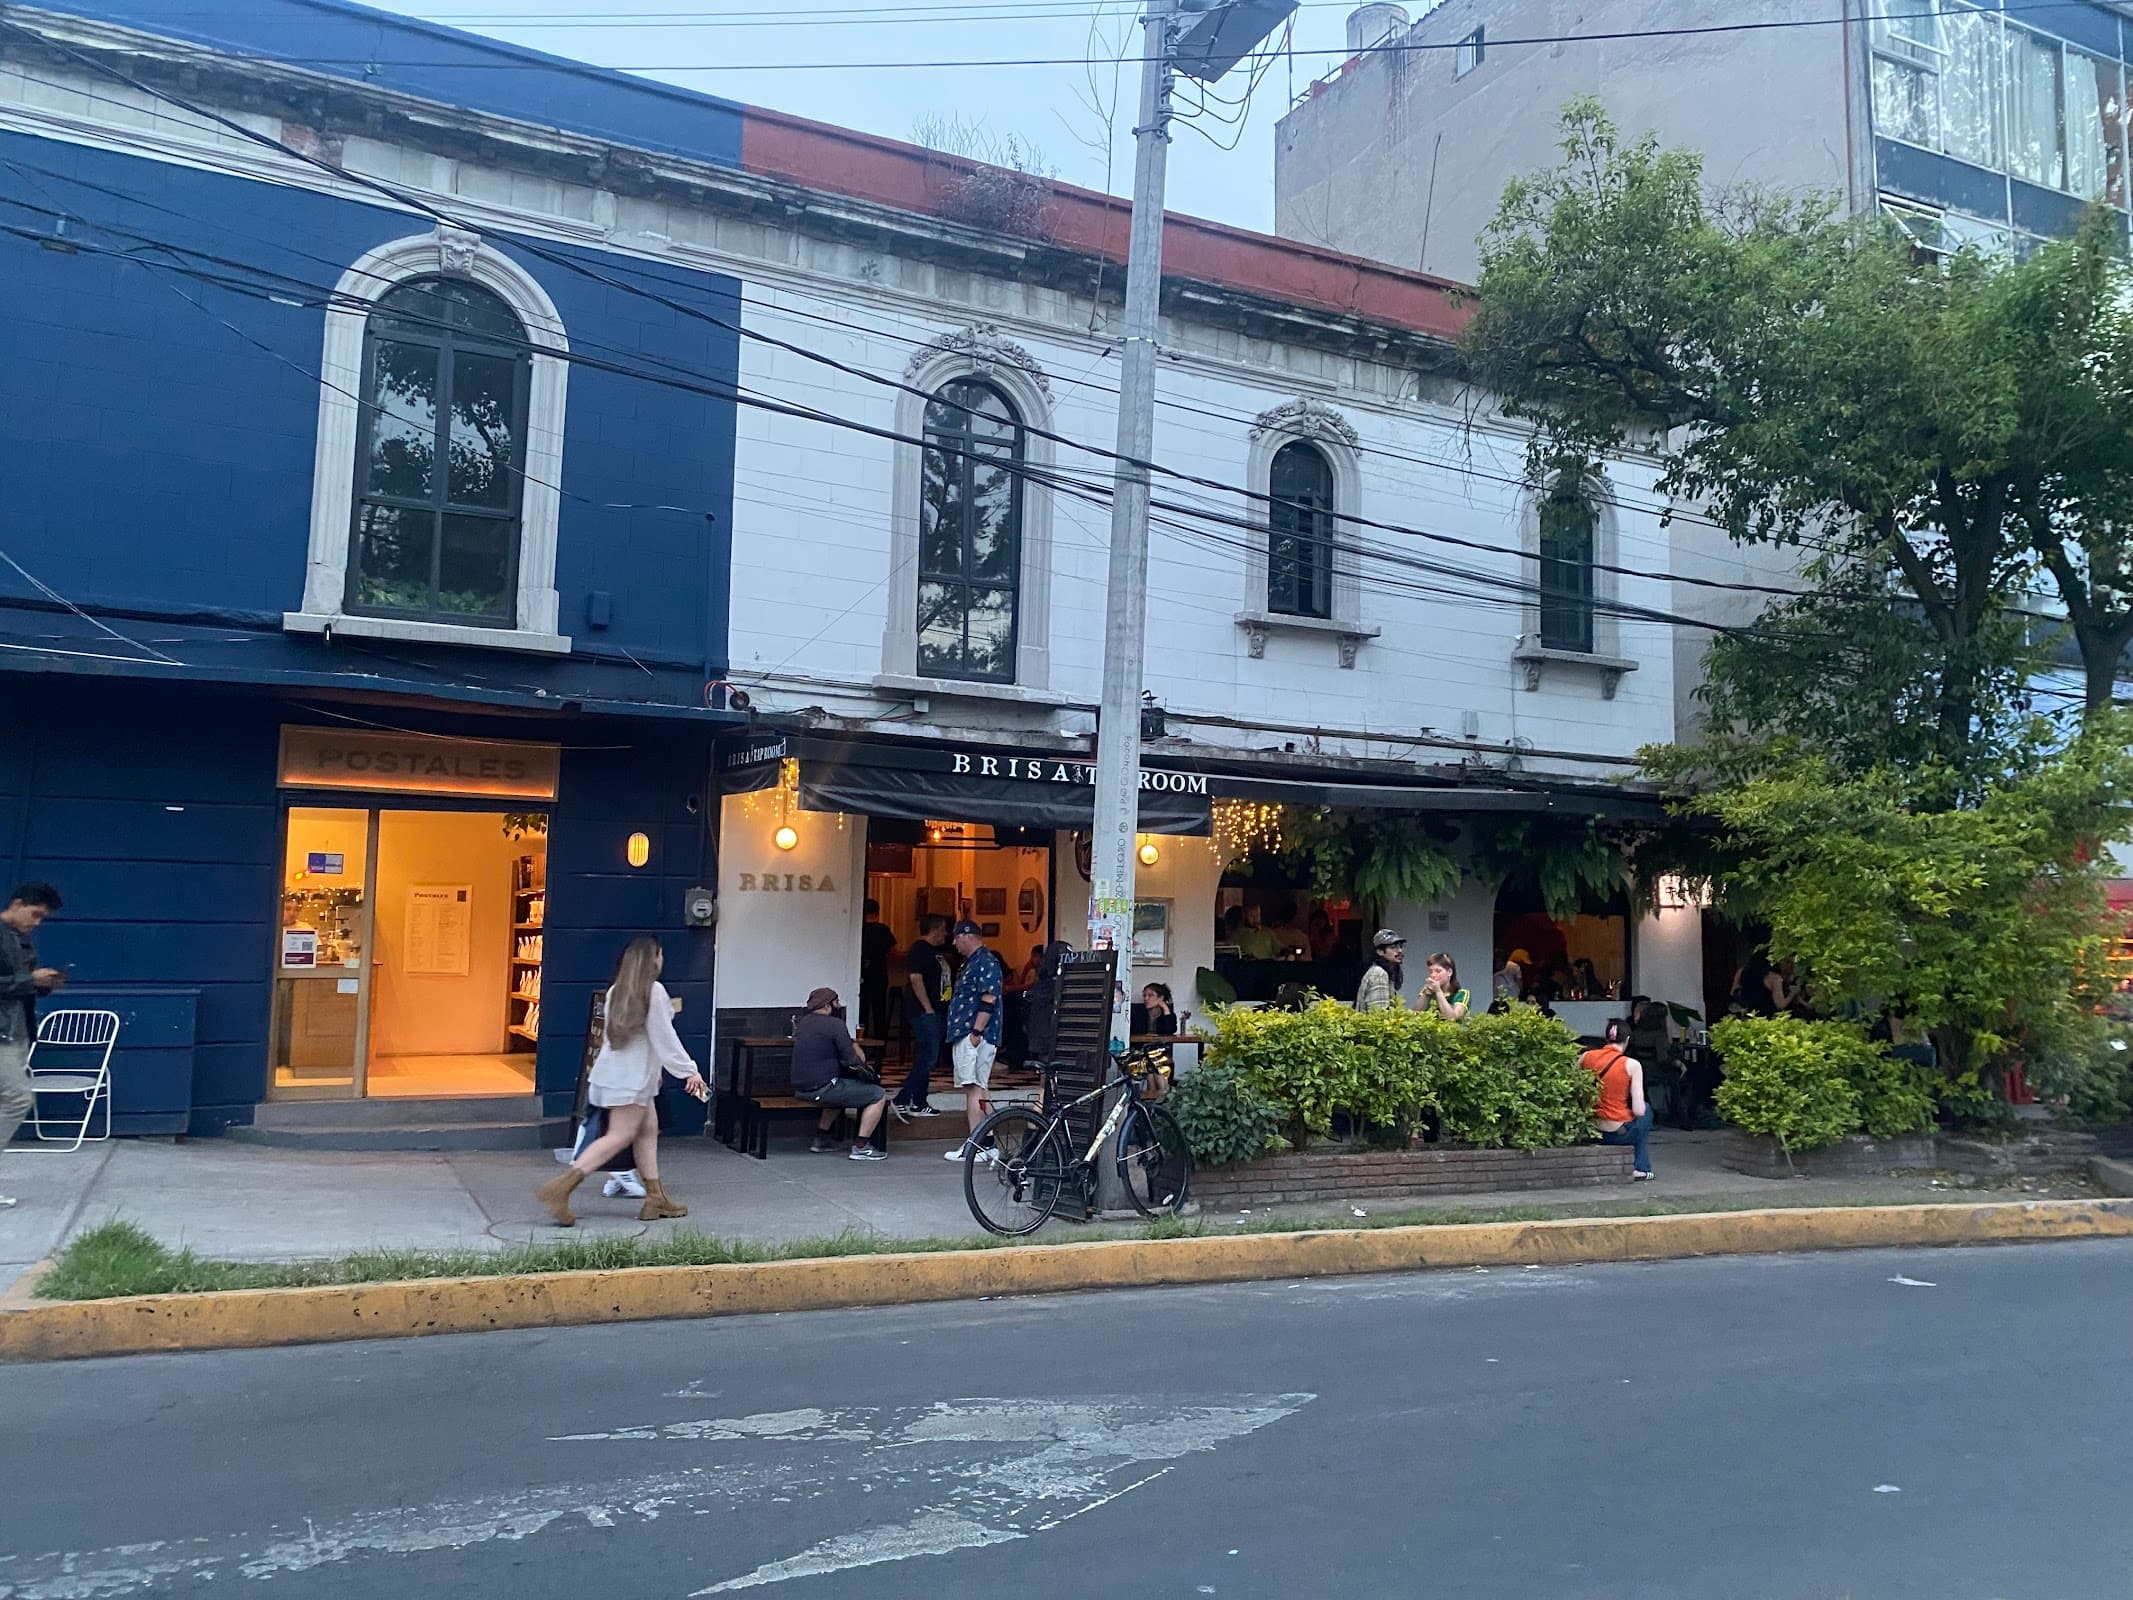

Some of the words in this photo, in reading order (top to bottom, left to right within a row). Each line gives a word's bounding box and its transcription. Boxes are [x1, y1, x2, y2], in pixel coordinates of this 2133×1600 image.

[317, 747, 527, 780] POSTALES
[952, 753, 1070, 782] BRISA
[1086, 767, 1208, 794] TROOM
[738, 872, 836, 892] BRISA
